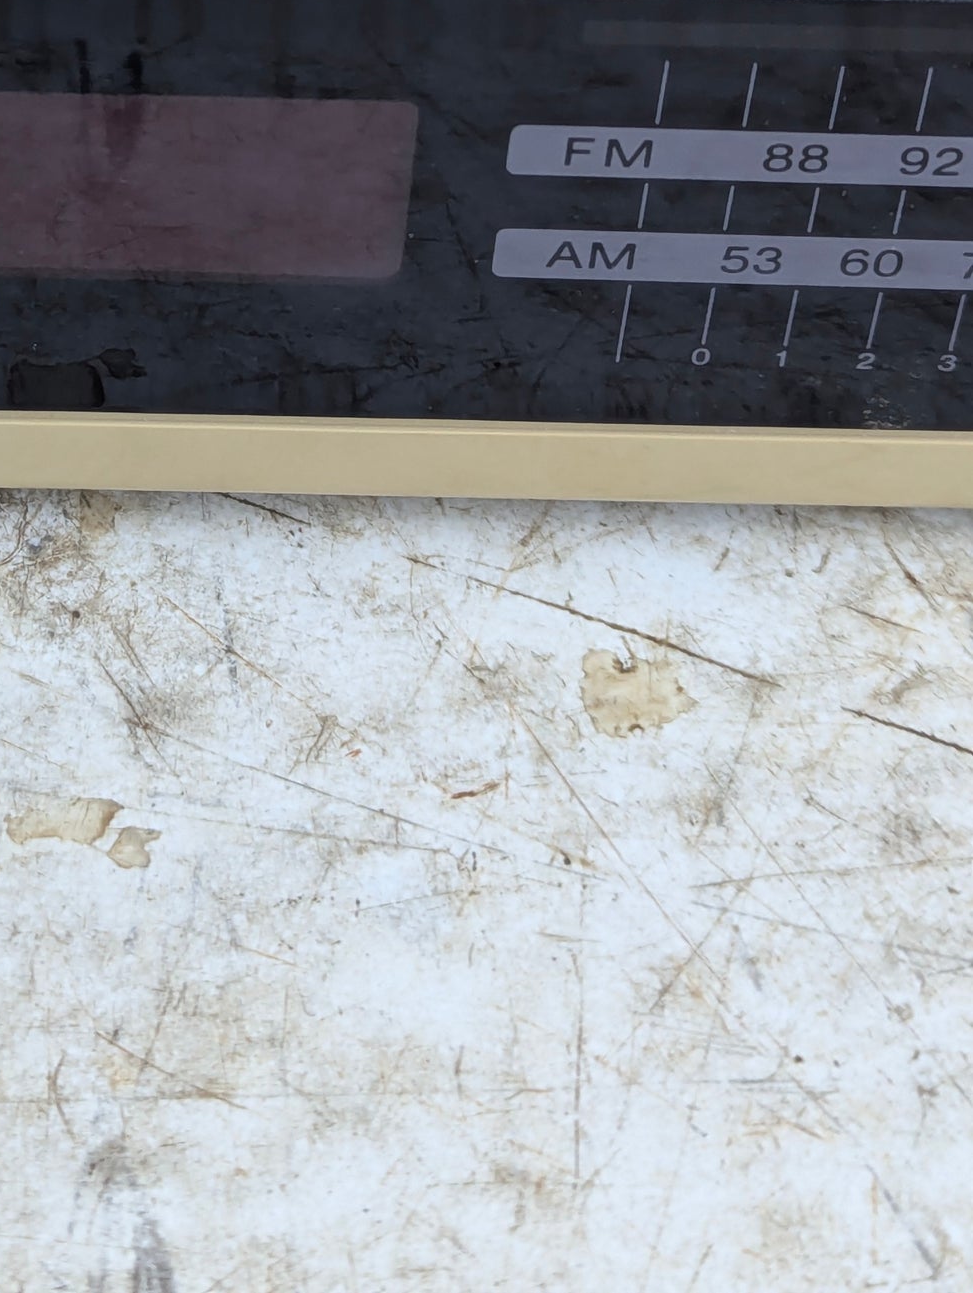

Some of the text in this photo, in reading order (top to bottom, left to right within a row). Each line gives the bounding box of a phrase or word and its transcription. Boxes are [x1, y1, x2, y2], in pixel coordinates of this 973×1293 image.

[564, 137, 964, 176] FM 88 92
[546, 240, 904, 278] AM 53 60
[691, 348, 957, 372] 0 1 2 3
